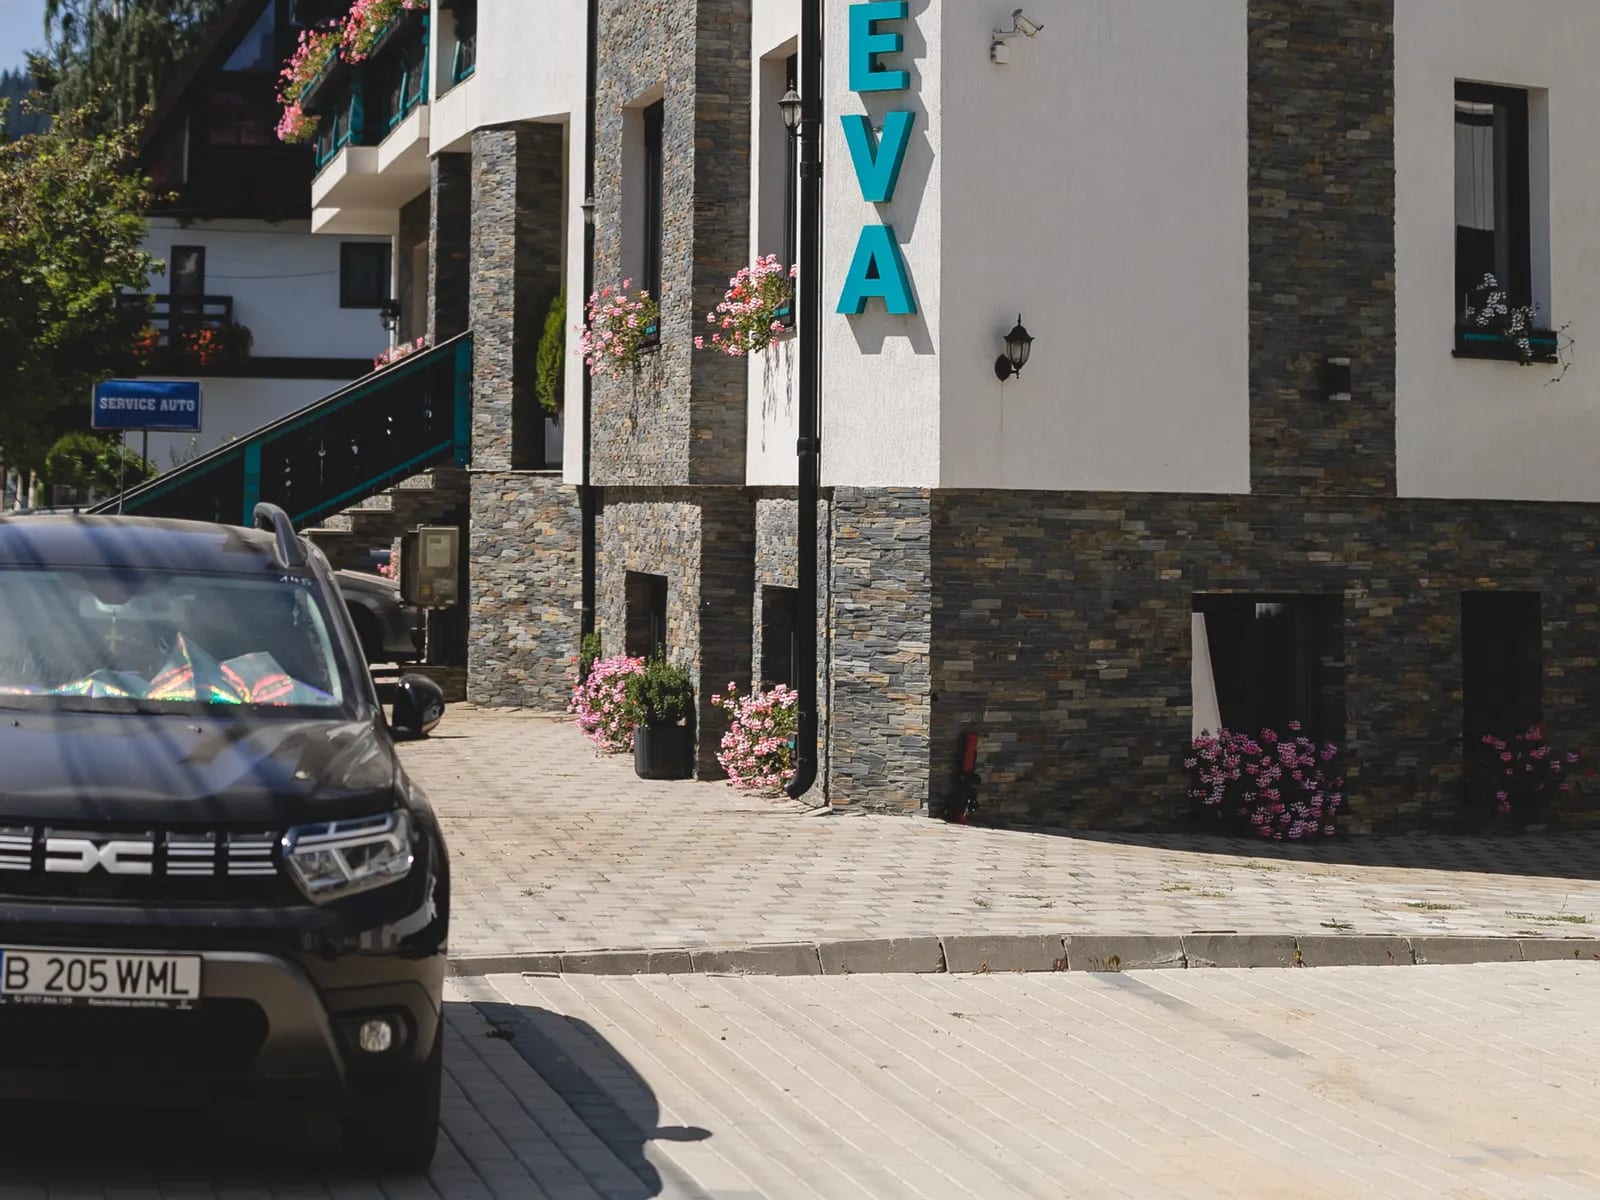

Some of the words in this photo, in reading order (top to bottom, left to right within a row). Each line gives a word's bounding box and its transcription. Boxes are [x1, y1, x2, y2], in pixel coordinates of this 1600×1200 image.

[100, 397, 156, 410] SERVICE
[160, 399, 195, 412] AUTO
[5, 956, 29, 990] B
[44, 958, 107, 992] 205
[116, 959, 189, 995] WML
